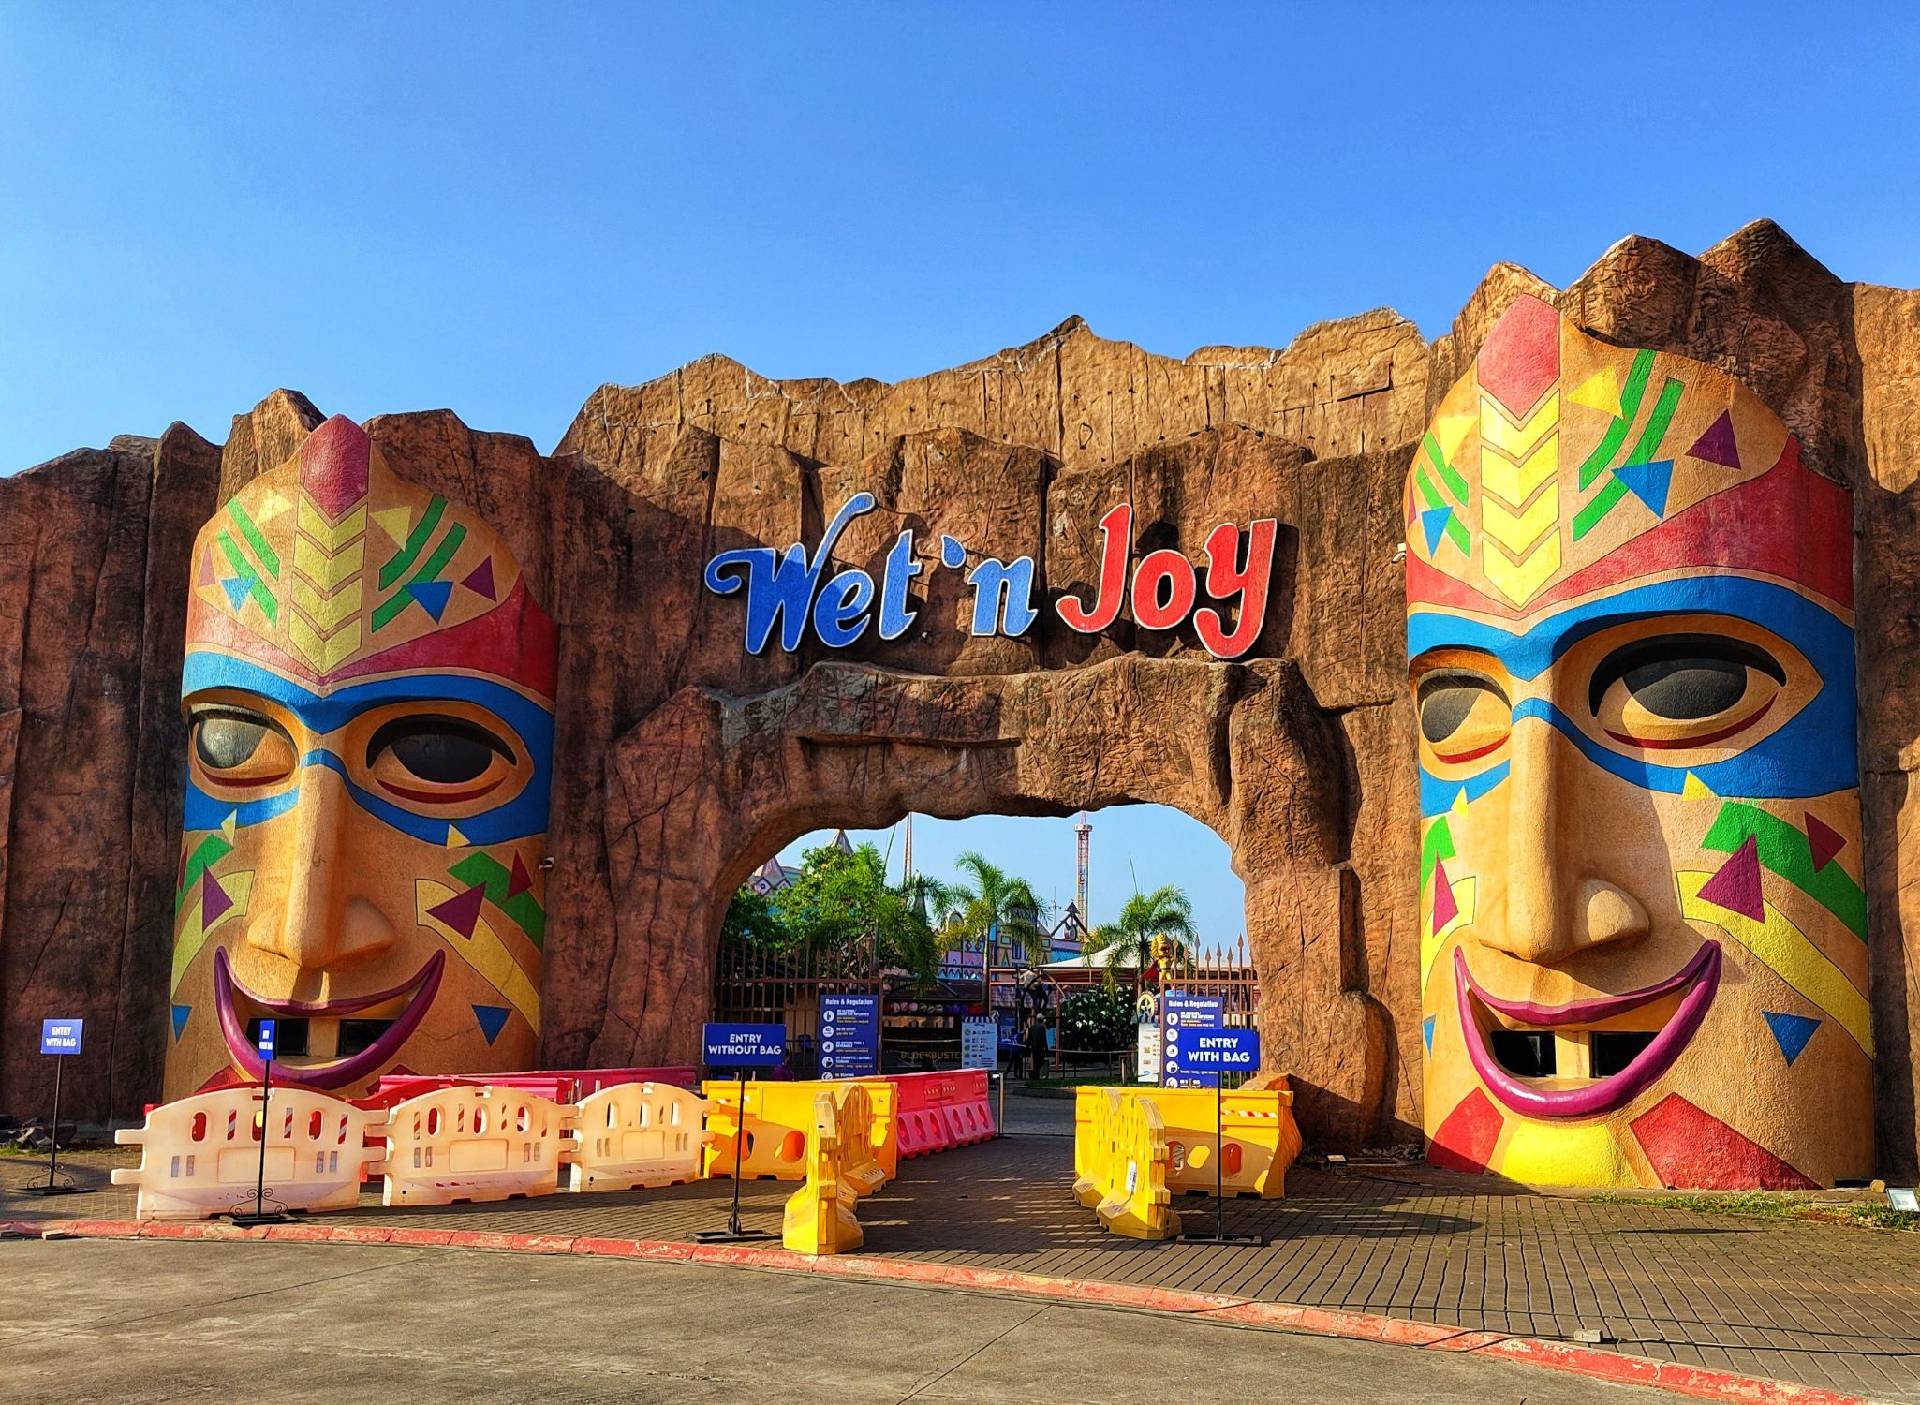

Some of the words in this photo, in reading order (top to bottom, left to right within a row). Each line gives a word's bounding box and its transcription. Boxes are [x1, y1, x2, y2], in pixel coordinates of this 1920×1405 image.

[704, 491, 919, 656] Wet
[1056, 503, 1279, 659] Joy
[51, 1026, 72, 1036] ENTRY
[46, 1037, 62, 1047] WITH
[62, 1037, 77, 1047] BAG
[730, 1033, 762, 1043] ENTRY
[1199, 1037, 1239, 1049] ENTRY
[708, 1045, 757, 1055] WITHOUT
[760, 1045, 782, 1055] BAG
[1187, 1051, 1219, 1062] WITH
[1222, 1051, 1250, 1062] BAG
